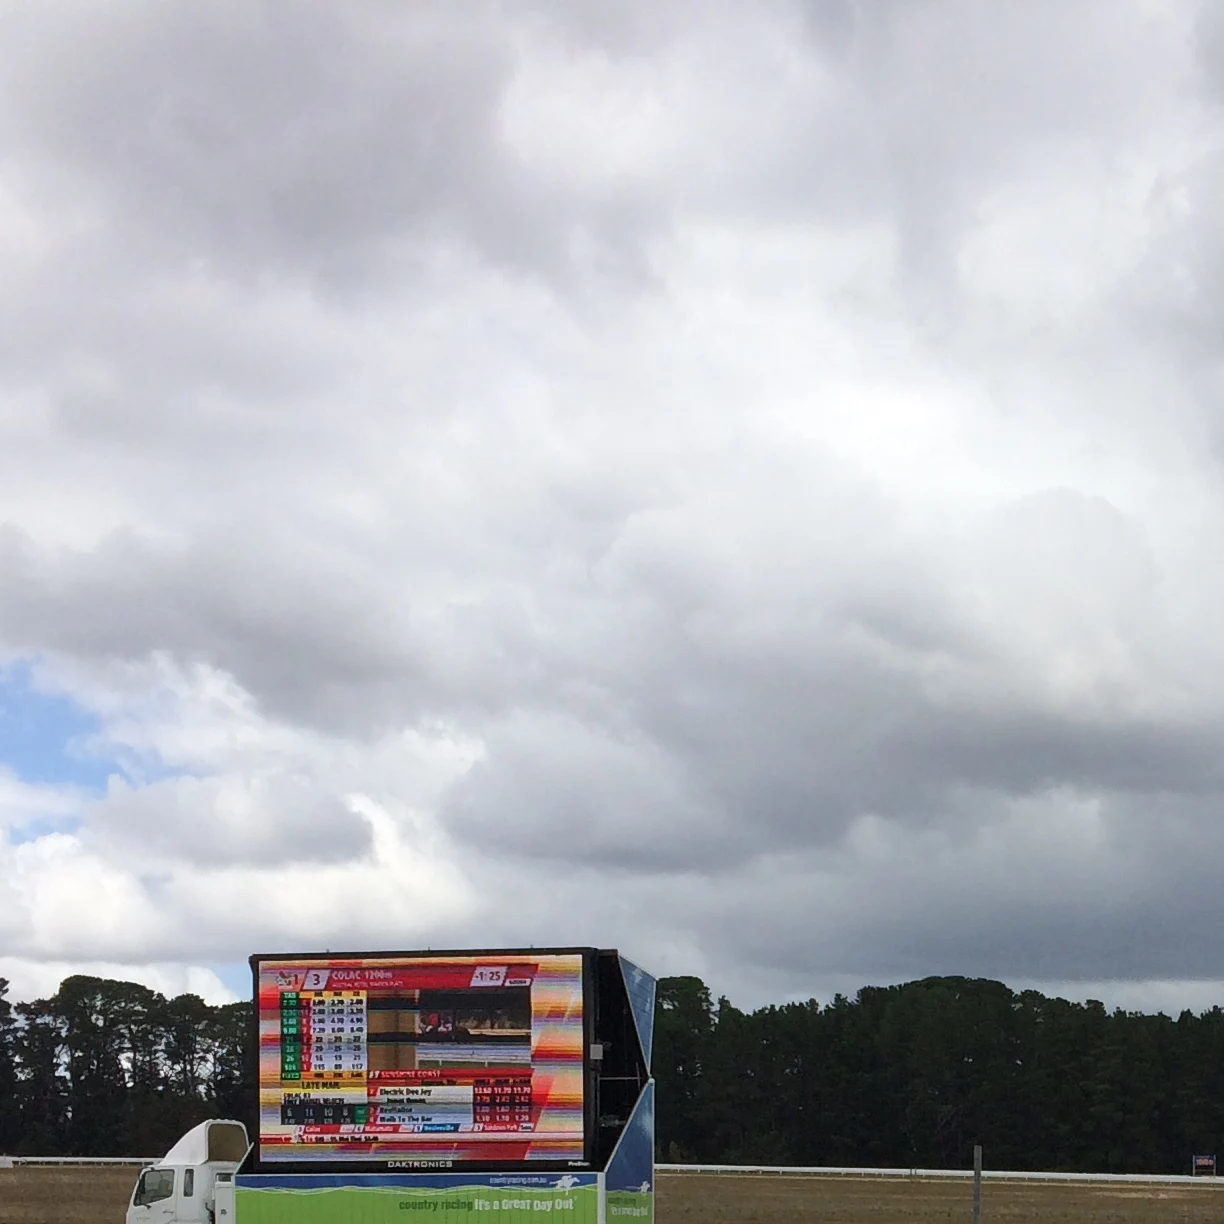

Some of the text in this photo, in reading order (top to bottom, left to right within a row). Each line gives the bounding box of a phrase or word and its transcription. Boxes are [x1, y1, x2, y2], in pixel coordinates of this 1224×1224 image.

[313, 974, 321, 985] 3
[332, 971, 361, 980] COLAC
[398, 1200, 438, 1212] country
[441, 1199, 474, 1212] racing
[533, 1200, 553, 1212] Day
[554, 1198, 574, 1210] Out
